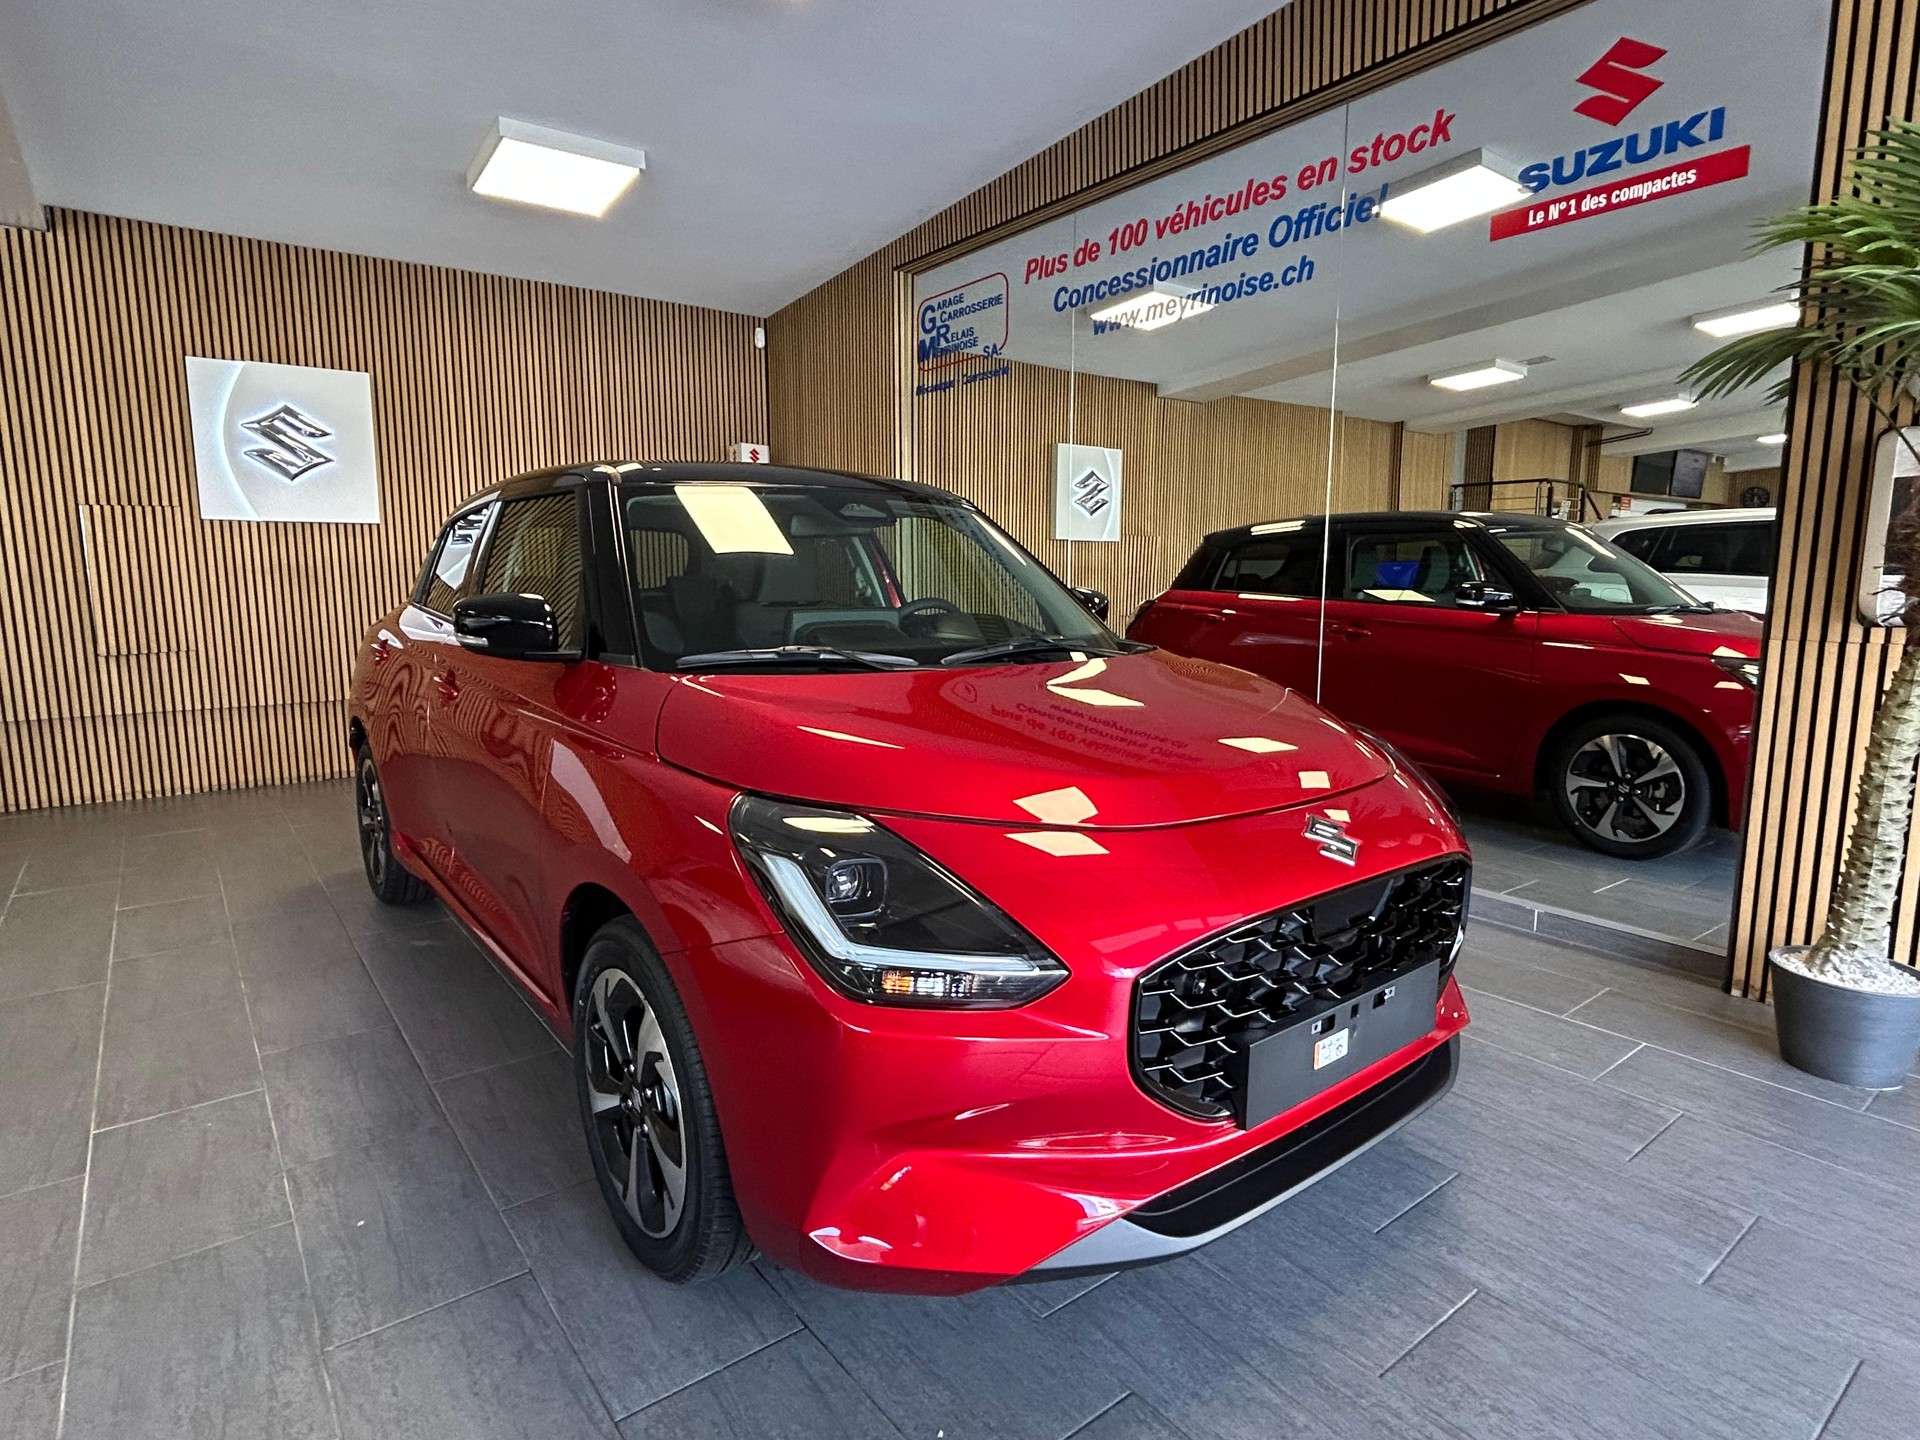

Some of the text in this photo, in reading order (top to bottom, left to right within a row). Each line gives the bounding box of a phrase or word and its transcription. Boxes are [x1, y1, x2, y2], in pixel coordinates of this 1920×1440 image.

[1518, 106, 1726, 194] SUZUKI
[1024, 108, 1456, 285] Plus de 100 véhicules en stock
[1528, 210, 1545, 226] Le
[1581, 194, 1607, 212] des
[1611, 168, 1697, 204] compactes
[939, 293, 1004, 324] CARROSSERIE
[1053, 231, 1260, 313] Concessionnaire
[1092, 254, 1316, 336] www.meyrinoise.ch
[935, 323, 975, 347] RELAIS
